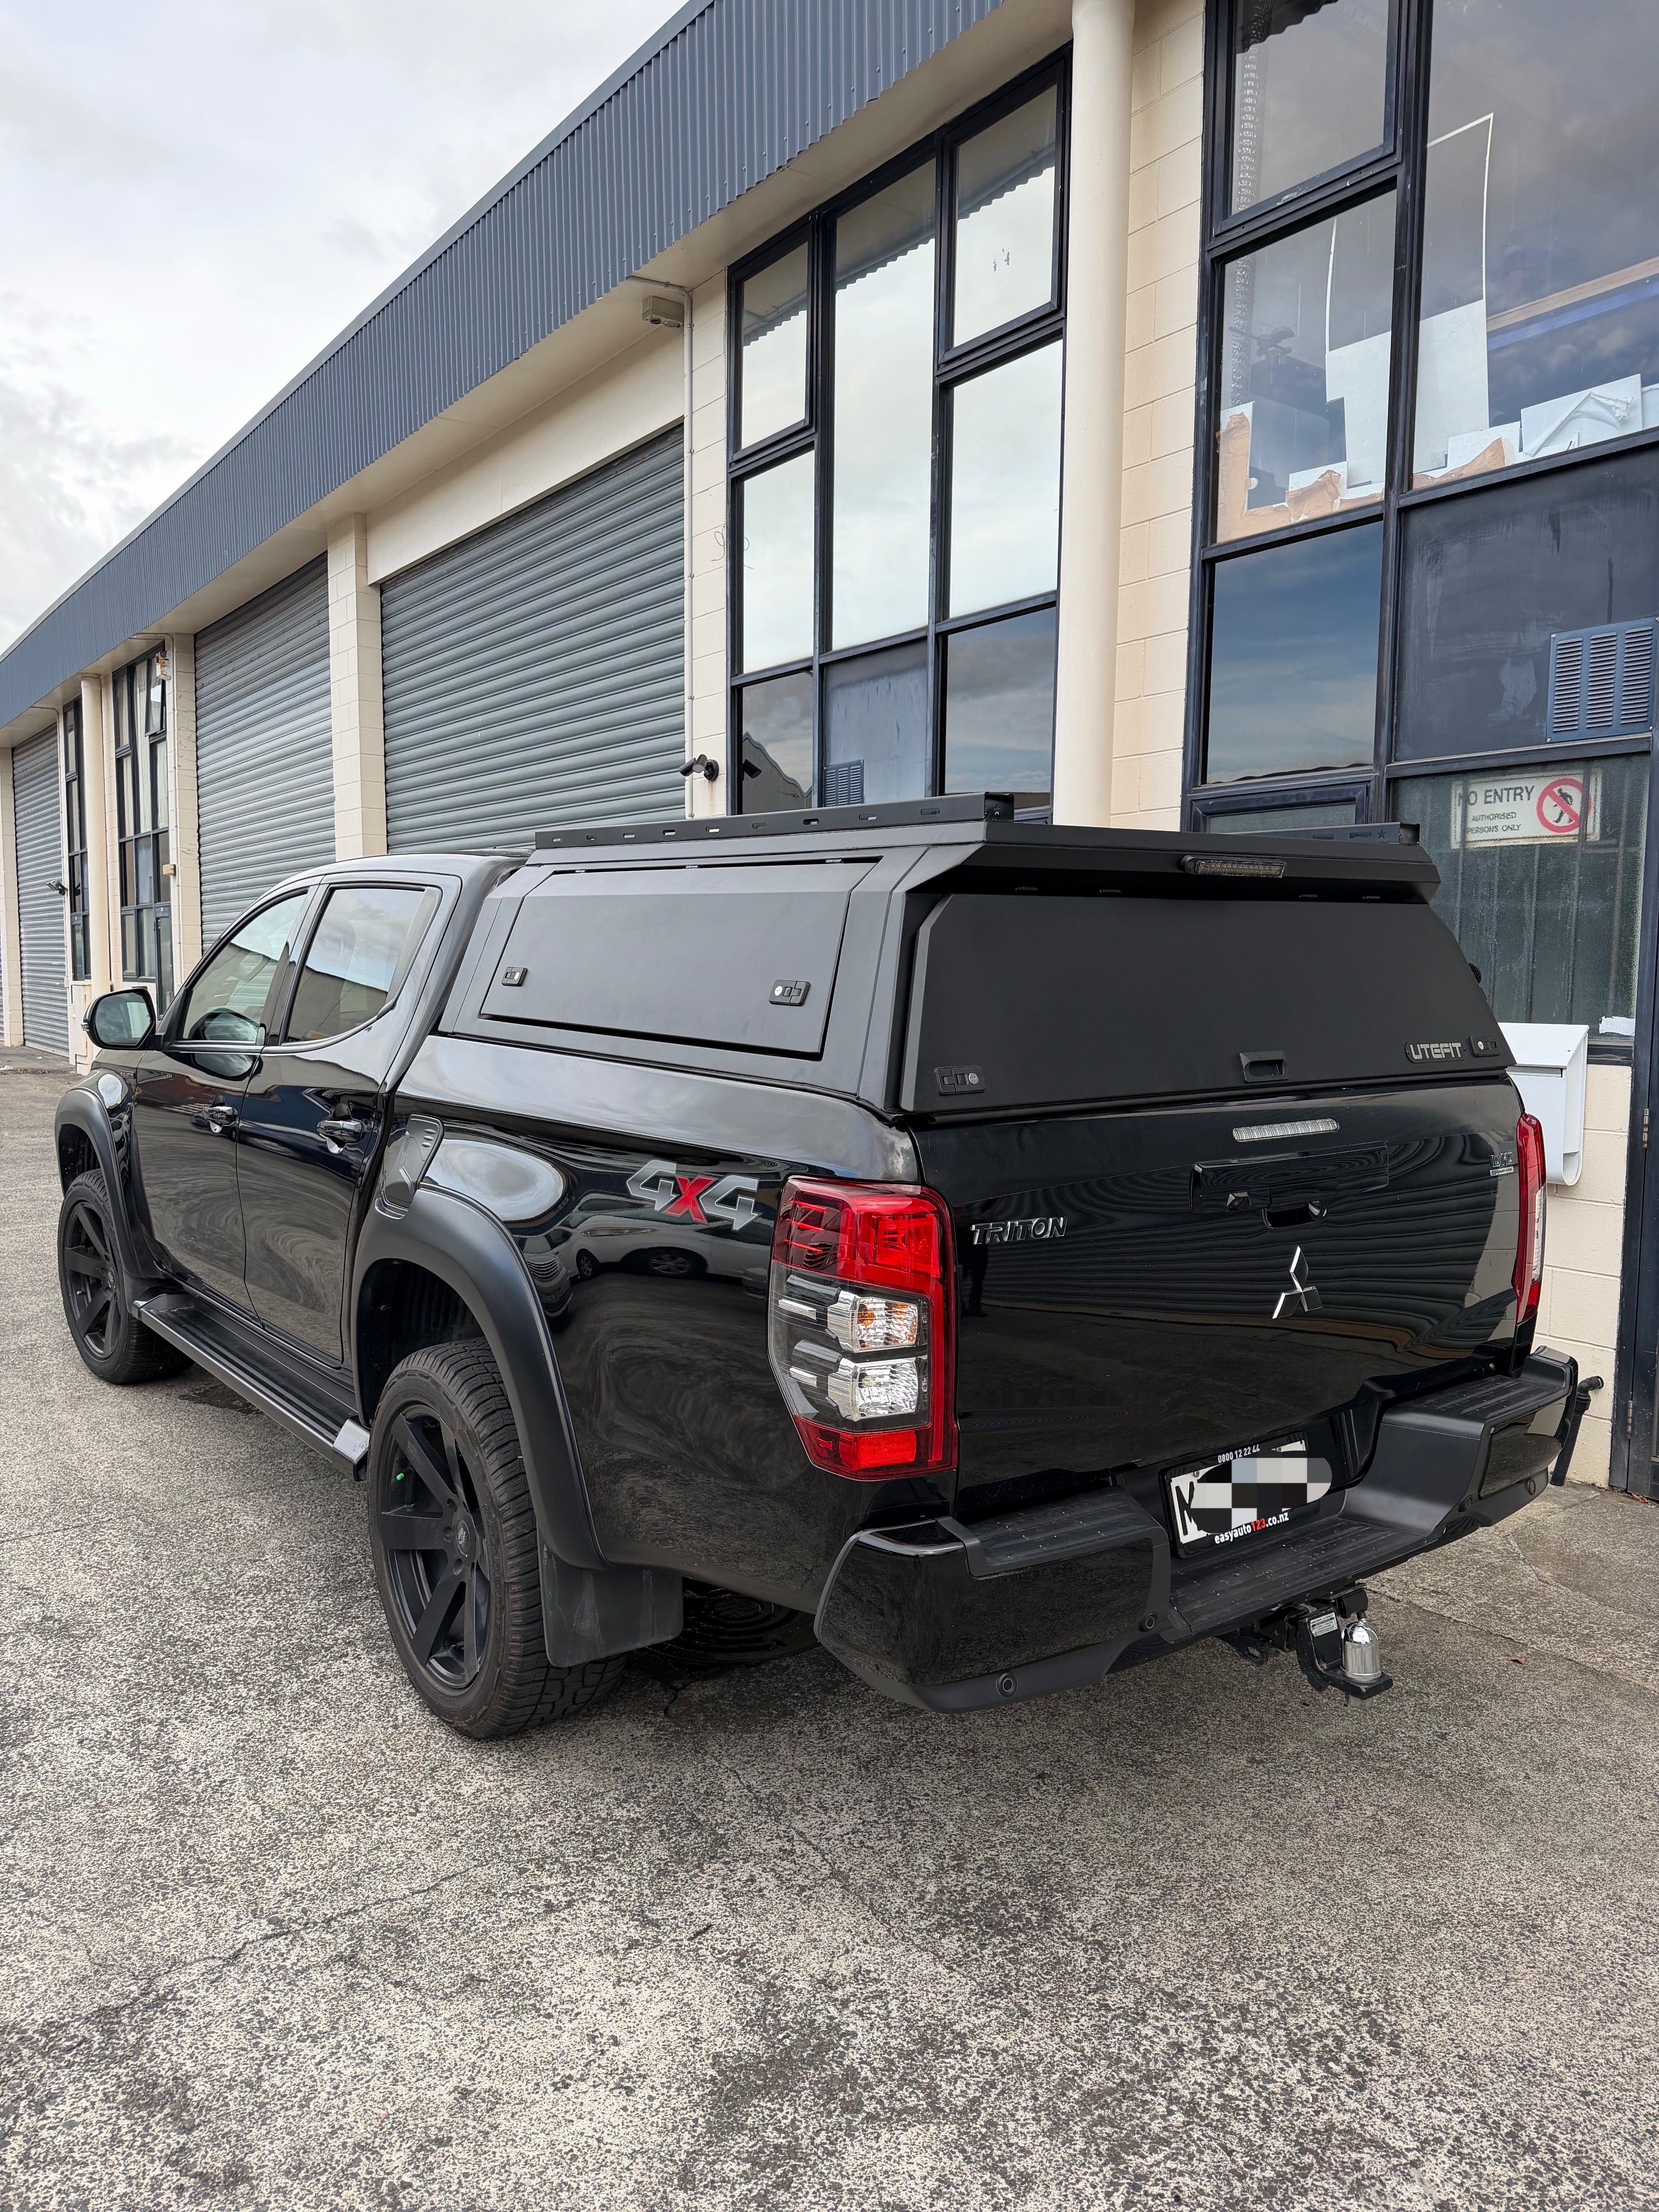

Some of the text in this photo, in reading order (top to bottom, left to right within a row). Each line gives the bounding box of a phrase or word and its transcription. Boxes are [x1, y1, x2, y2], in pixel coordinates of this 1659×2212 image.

[1484, 785, 1535, 804] ENTRY
[1471, 812, 1516, 821] AUTHORISED
[1410, 1042, 1462, 1059] UTEFIT
[971, 1217, 1068, 1245] TRITON
[1218, 1452, 1233, 1463] 0800
[1235, 1449, 1243, 1459] 12
[1243, 1446, 1251, 1456] 22
[1214, 1512, 1289, 1544] easyauto123.co.nz
